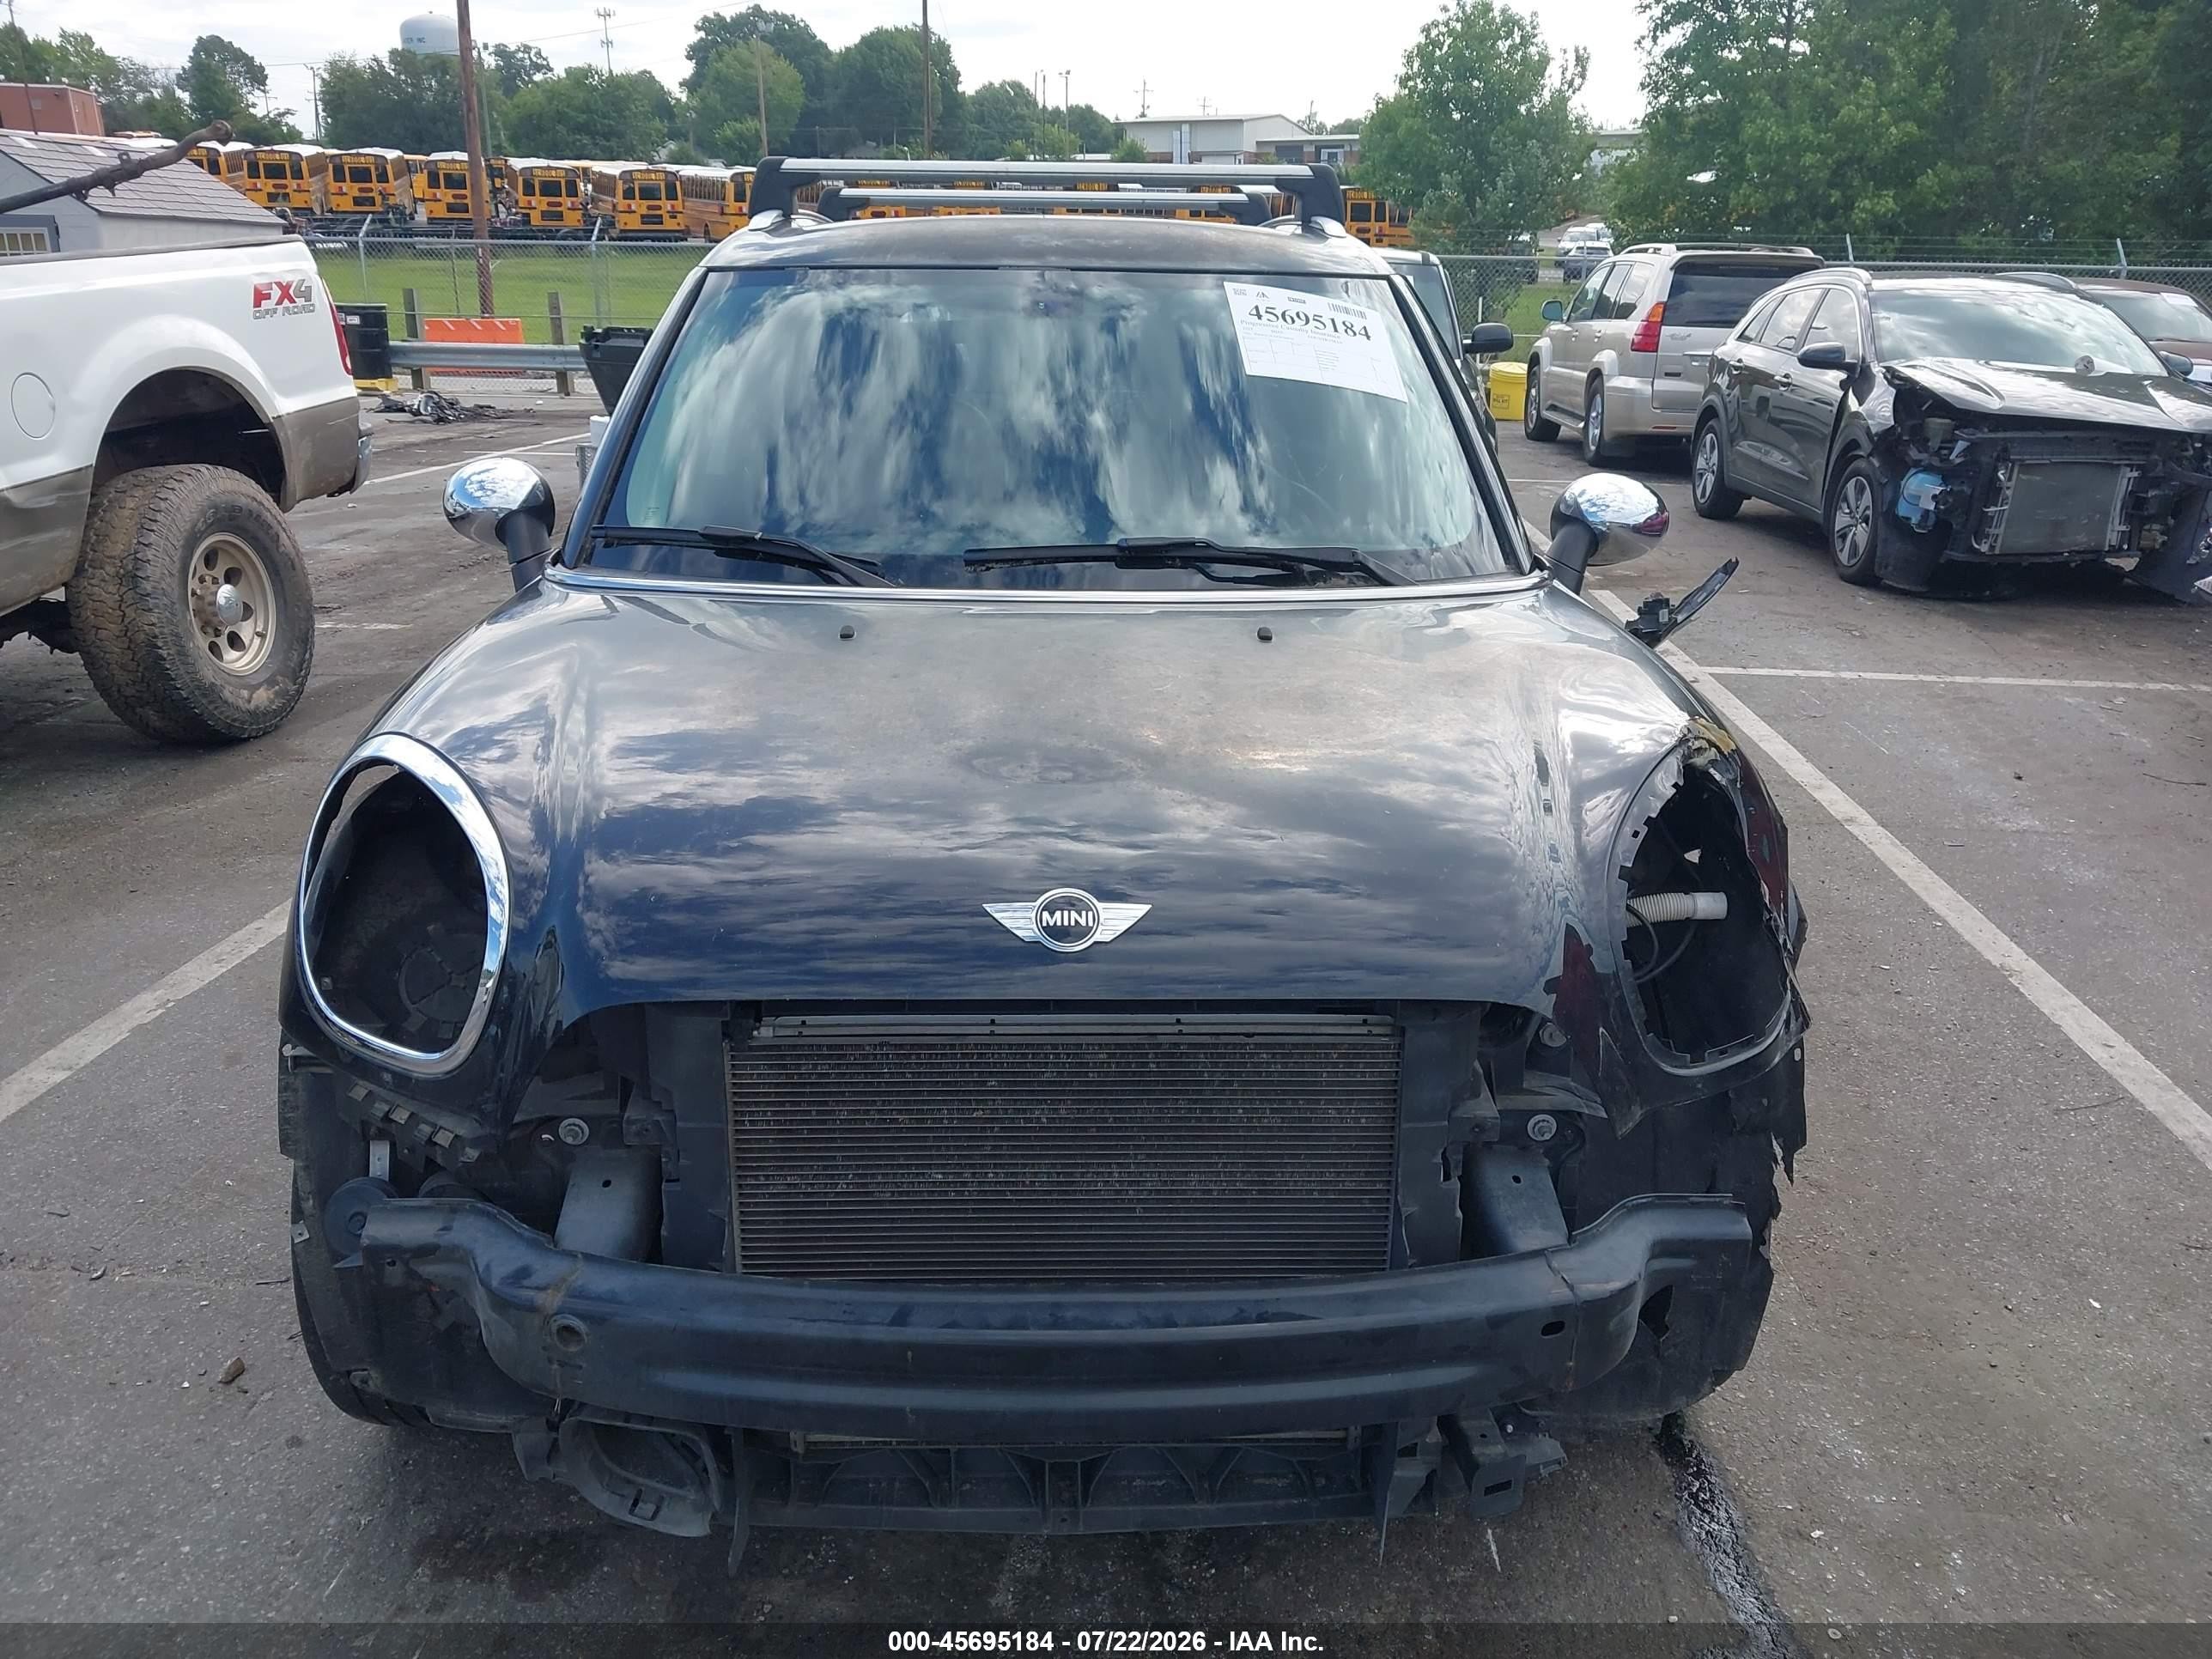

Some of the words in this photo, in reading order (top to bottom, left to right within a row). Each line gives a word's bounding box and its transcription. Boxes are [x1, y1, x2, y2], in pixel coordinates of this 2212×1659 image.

[253, 279, 312, 308] FX4
[253, 307, 278, 319] OFF
[282, 303, 316, 316] ROAD
[1249, 304, 1371, 341] 45695184
[1042, 910, 1094, 927] MINI
